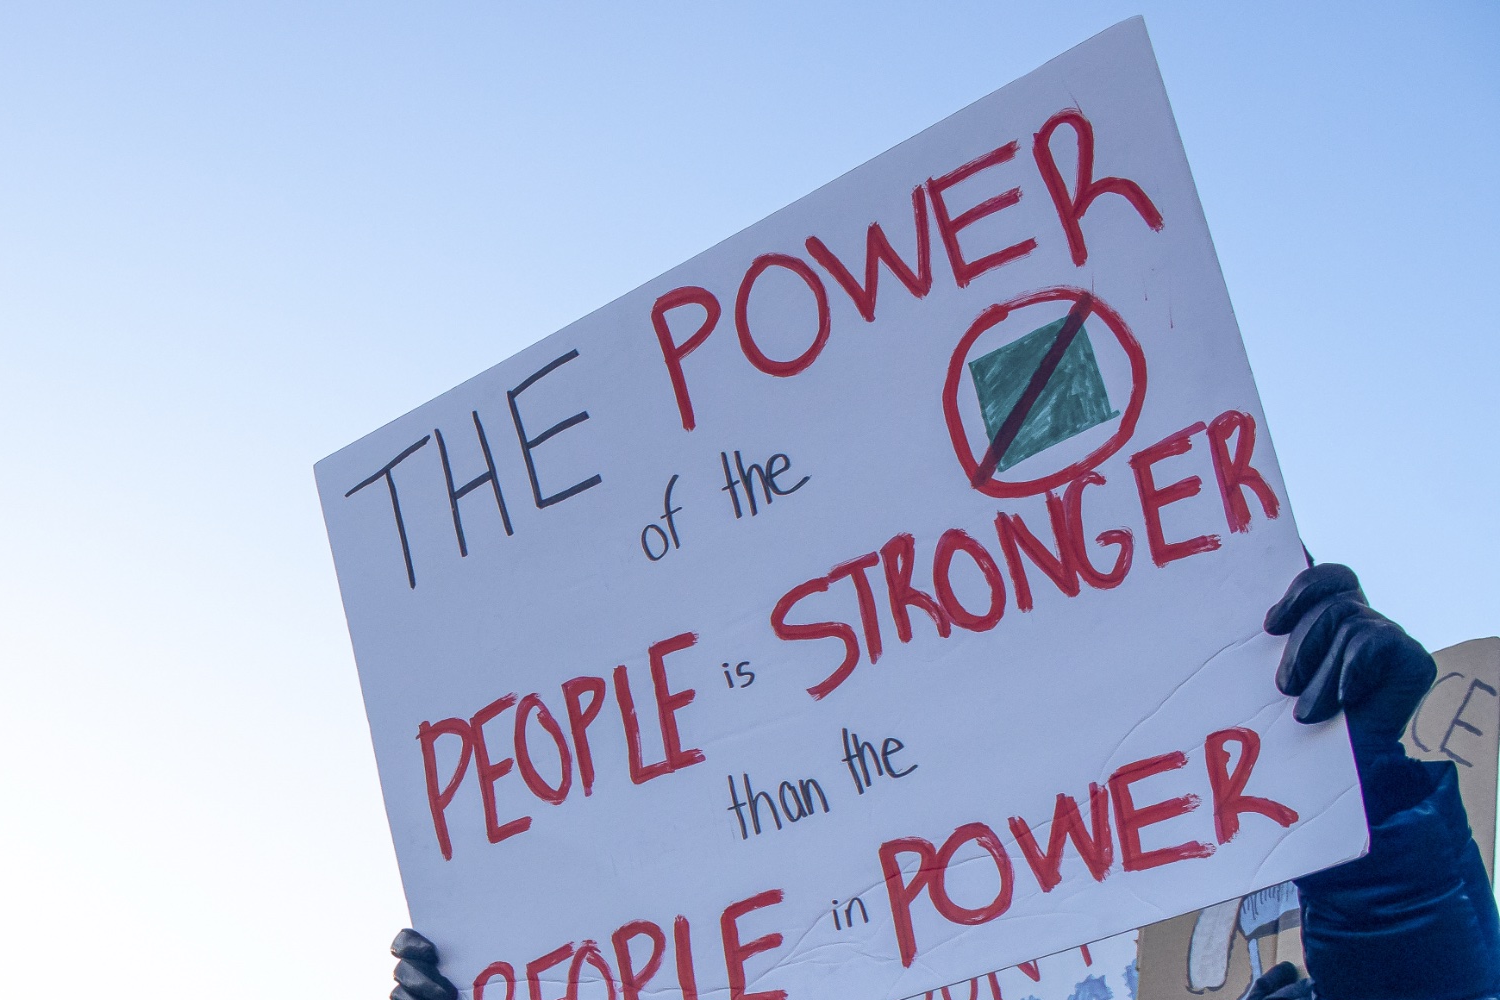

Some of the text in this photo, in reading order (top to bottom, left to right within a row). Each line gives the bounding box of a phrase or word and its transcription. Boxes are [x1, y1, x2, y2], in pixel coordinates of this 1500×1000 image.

[344, 107, 1165, 590] THE POWER
[640, 450, 812, 562] of the
[415, 409, 1280, 861] PEOPLE is STRONGER
[727, 727, 919, 840] than the
[831, 896, 870, 931] in
[878, 727, 1299, 968] POWER
